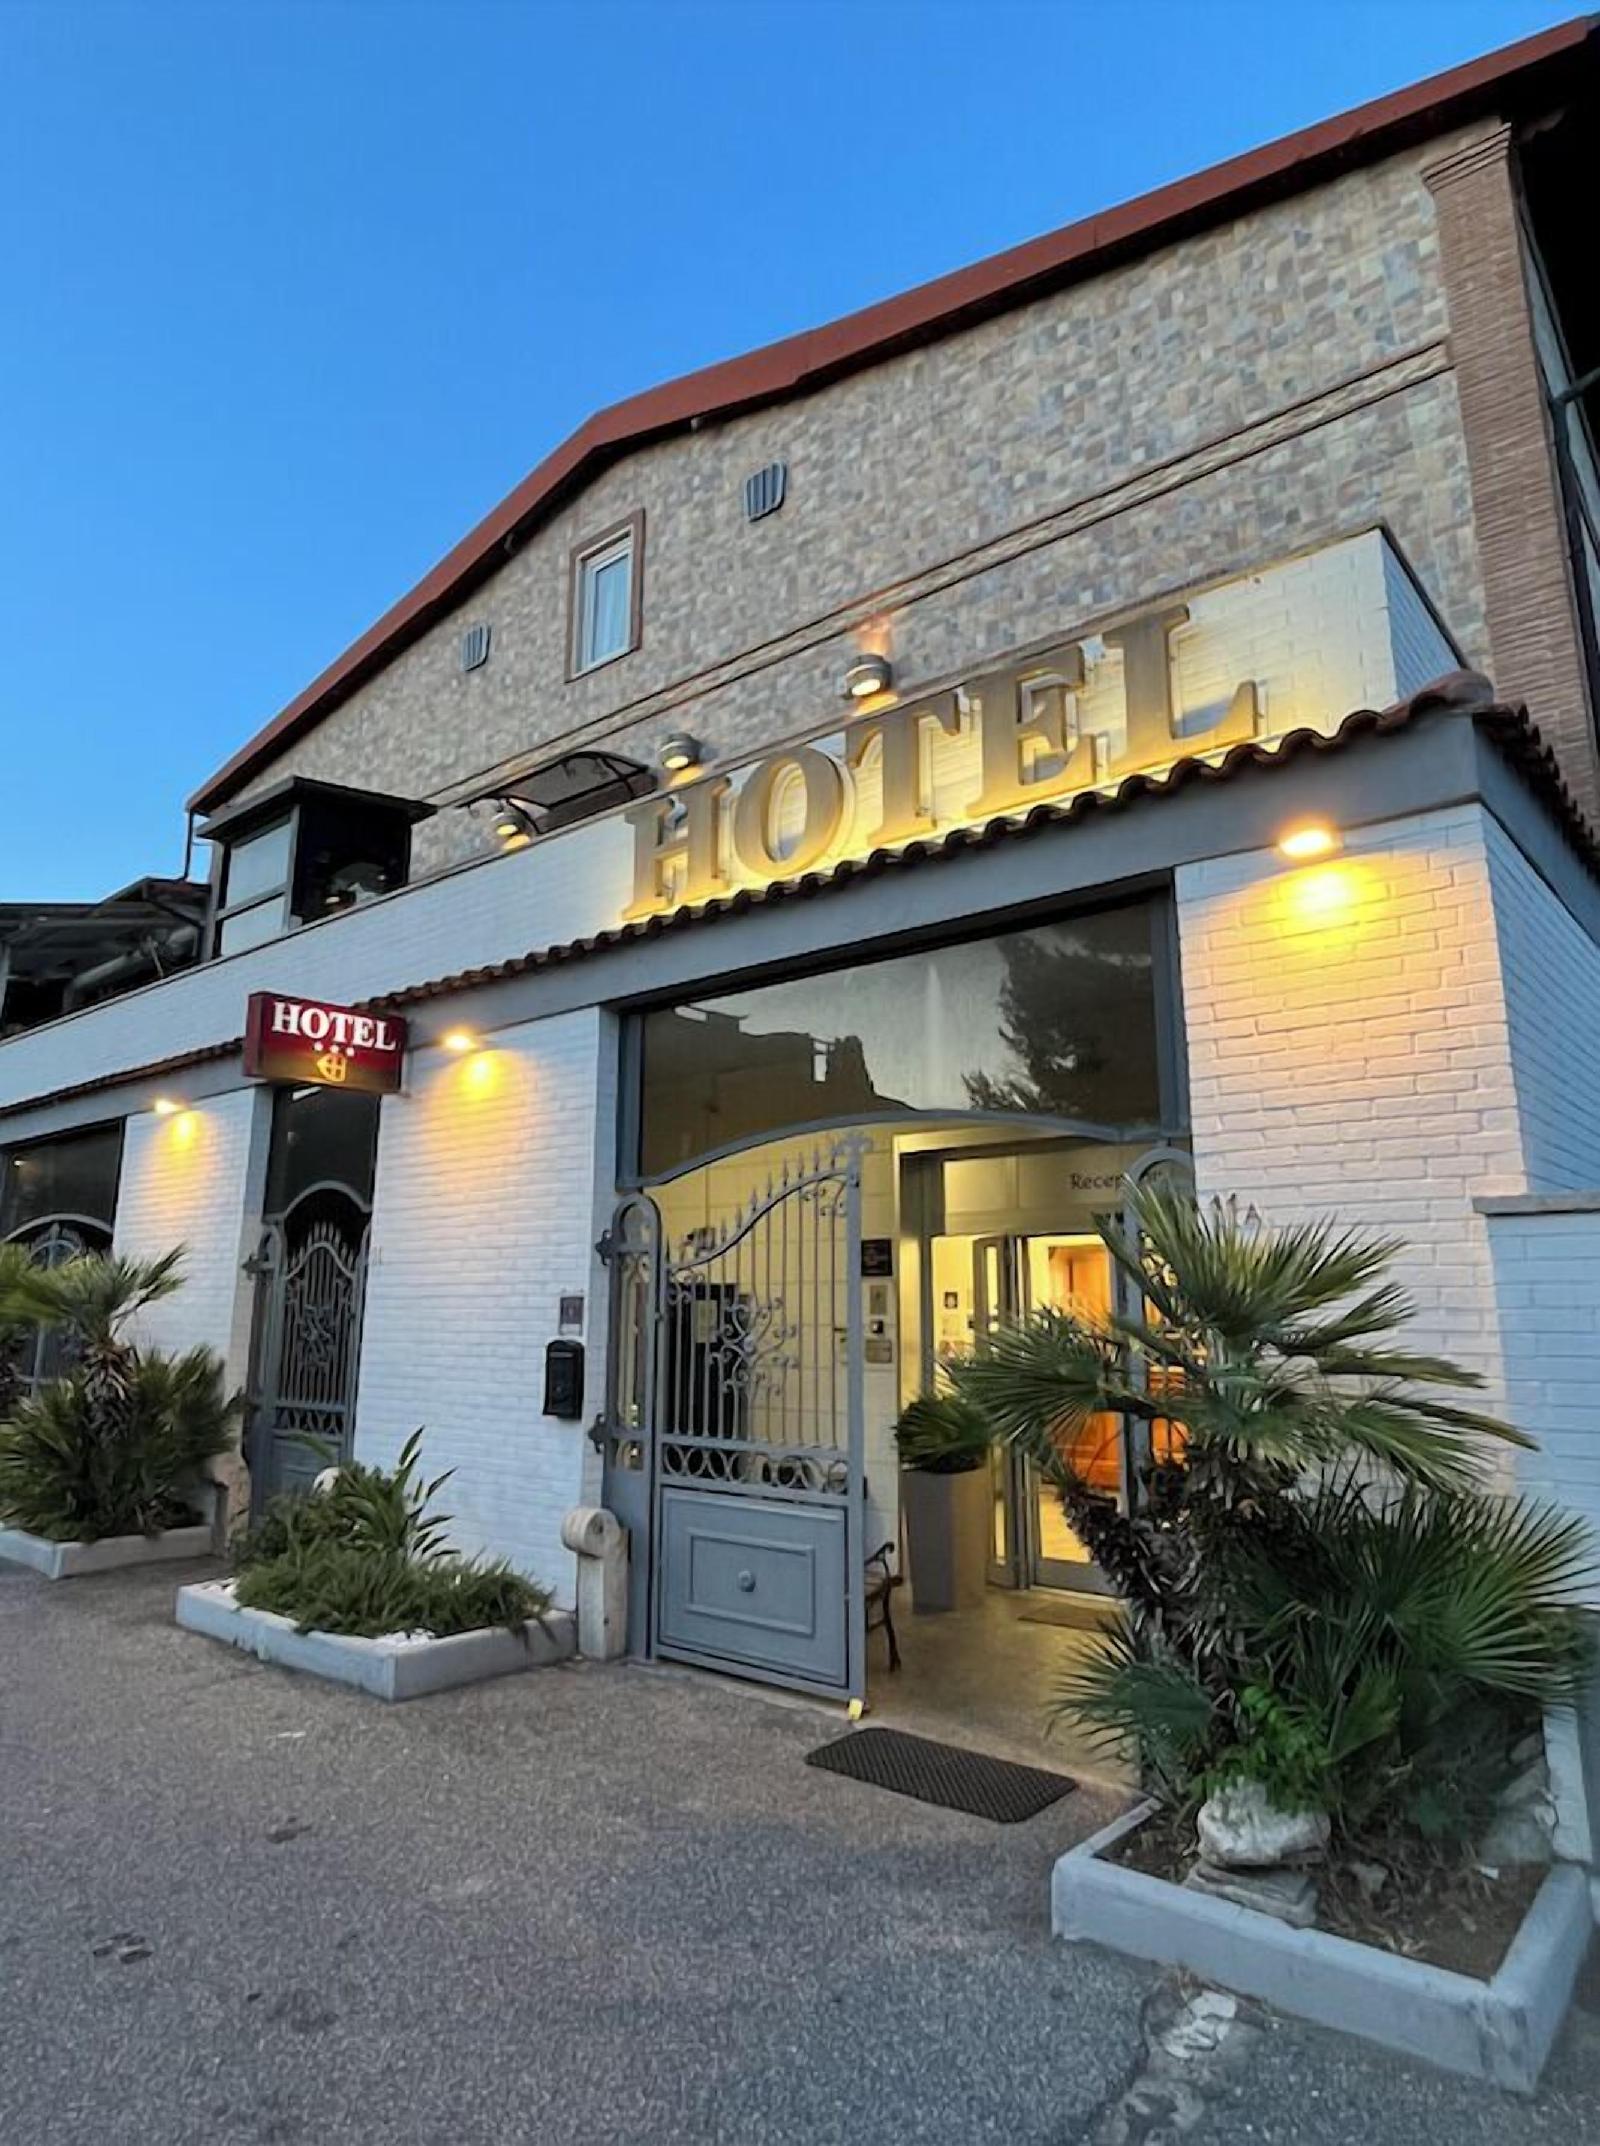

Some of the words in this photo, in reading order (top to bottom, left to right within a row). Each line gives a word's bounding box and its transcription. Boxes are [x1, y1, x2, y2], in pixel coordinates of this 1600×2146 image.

[624, 604, 1258, 920] HOTEL
[271, 1001, 397, 1051] HOTEL
[1070, 1171, 1161, 1192] Recep
